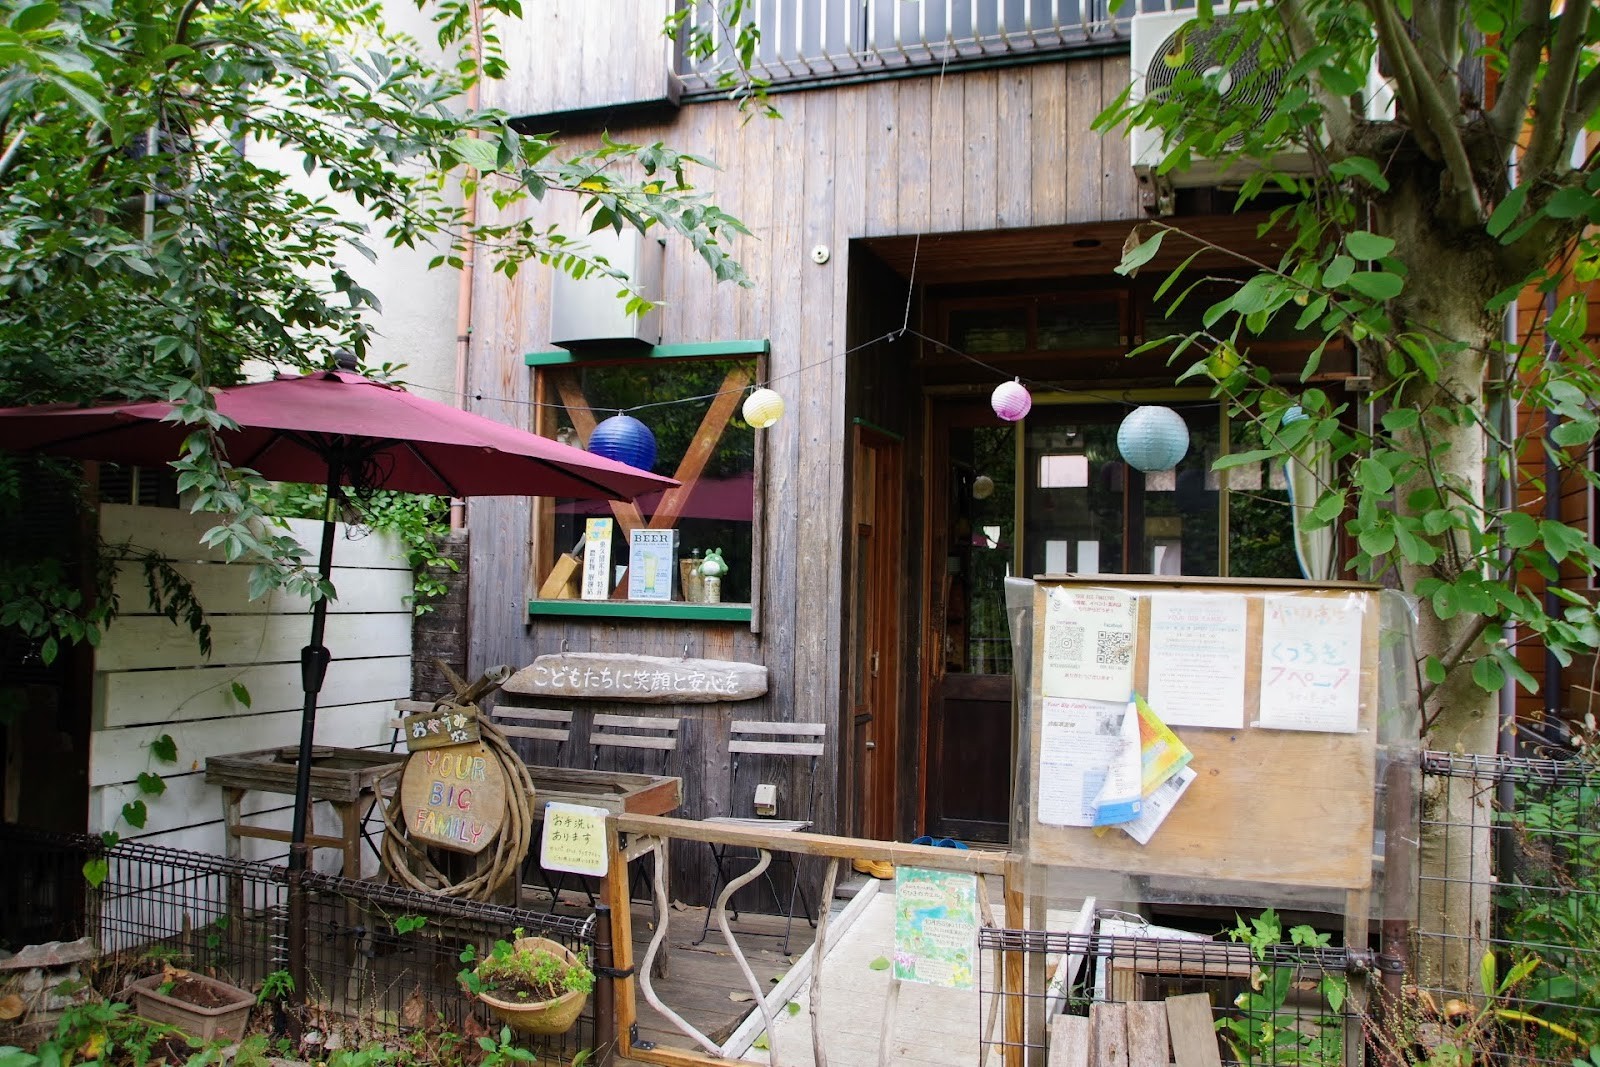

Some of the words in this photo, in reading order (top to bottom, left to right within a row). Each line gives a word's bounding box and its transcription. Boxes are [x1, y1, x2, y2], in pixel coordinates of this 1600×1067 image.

[634, 534, 668, 542] BEER
[534, 666, 739, 694] こどもたちに笑顔と安心を
[412, 712, 467, 738] おやすみ
[425, 751, 486, 781] YOUR
[429, 781, 472, 812] BIG
[414, 808, 485, 844] FAMILY
[553, 814, 594, 829] お手洗い
[552, 831, 591, 845] あります
